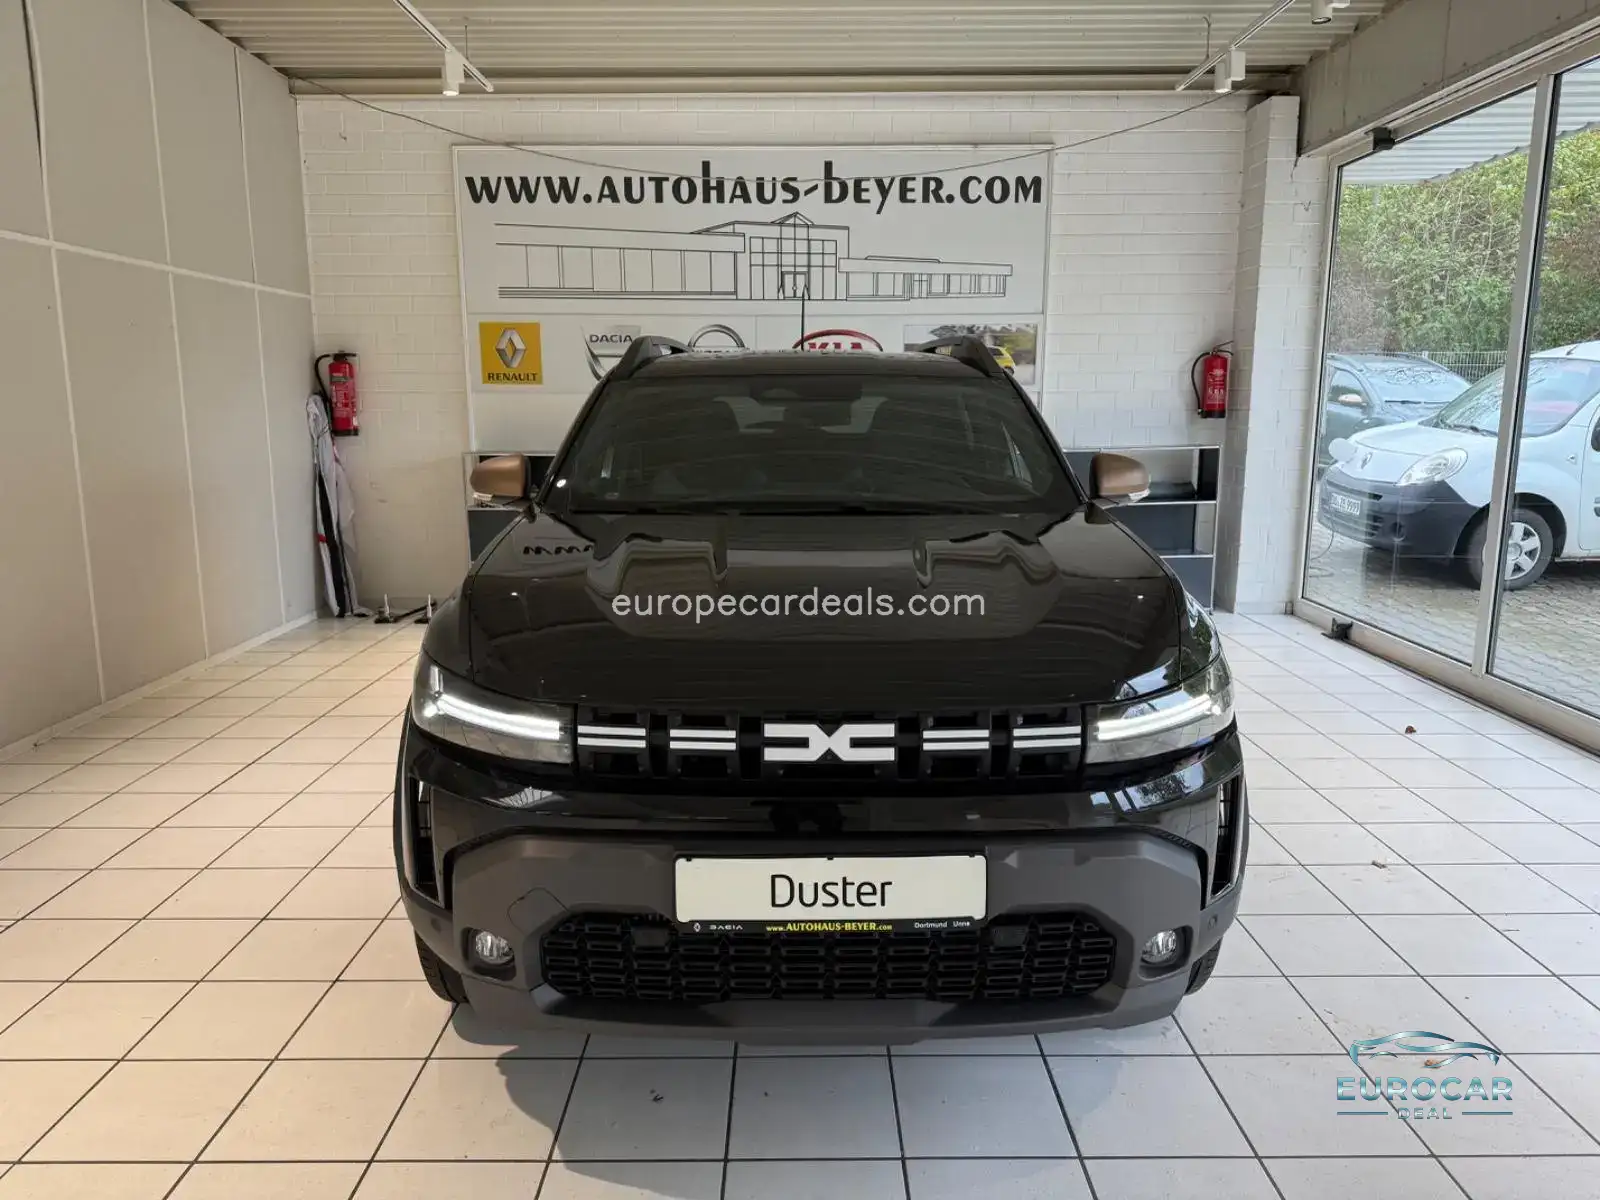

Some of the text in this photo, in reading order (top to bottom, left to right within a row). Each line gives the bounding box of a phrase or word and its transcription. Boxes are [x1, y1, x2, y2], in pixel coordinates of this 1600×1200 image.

[589, 334, 633, 343] DACIA
[487, 372, 538, 381] RENAULT
[770, 873, 893, 908] Duster
[766, 922, 893, 932] www.AUTOHAUS-BEYER.com
[914, 921, 948, 929] Dortmund
